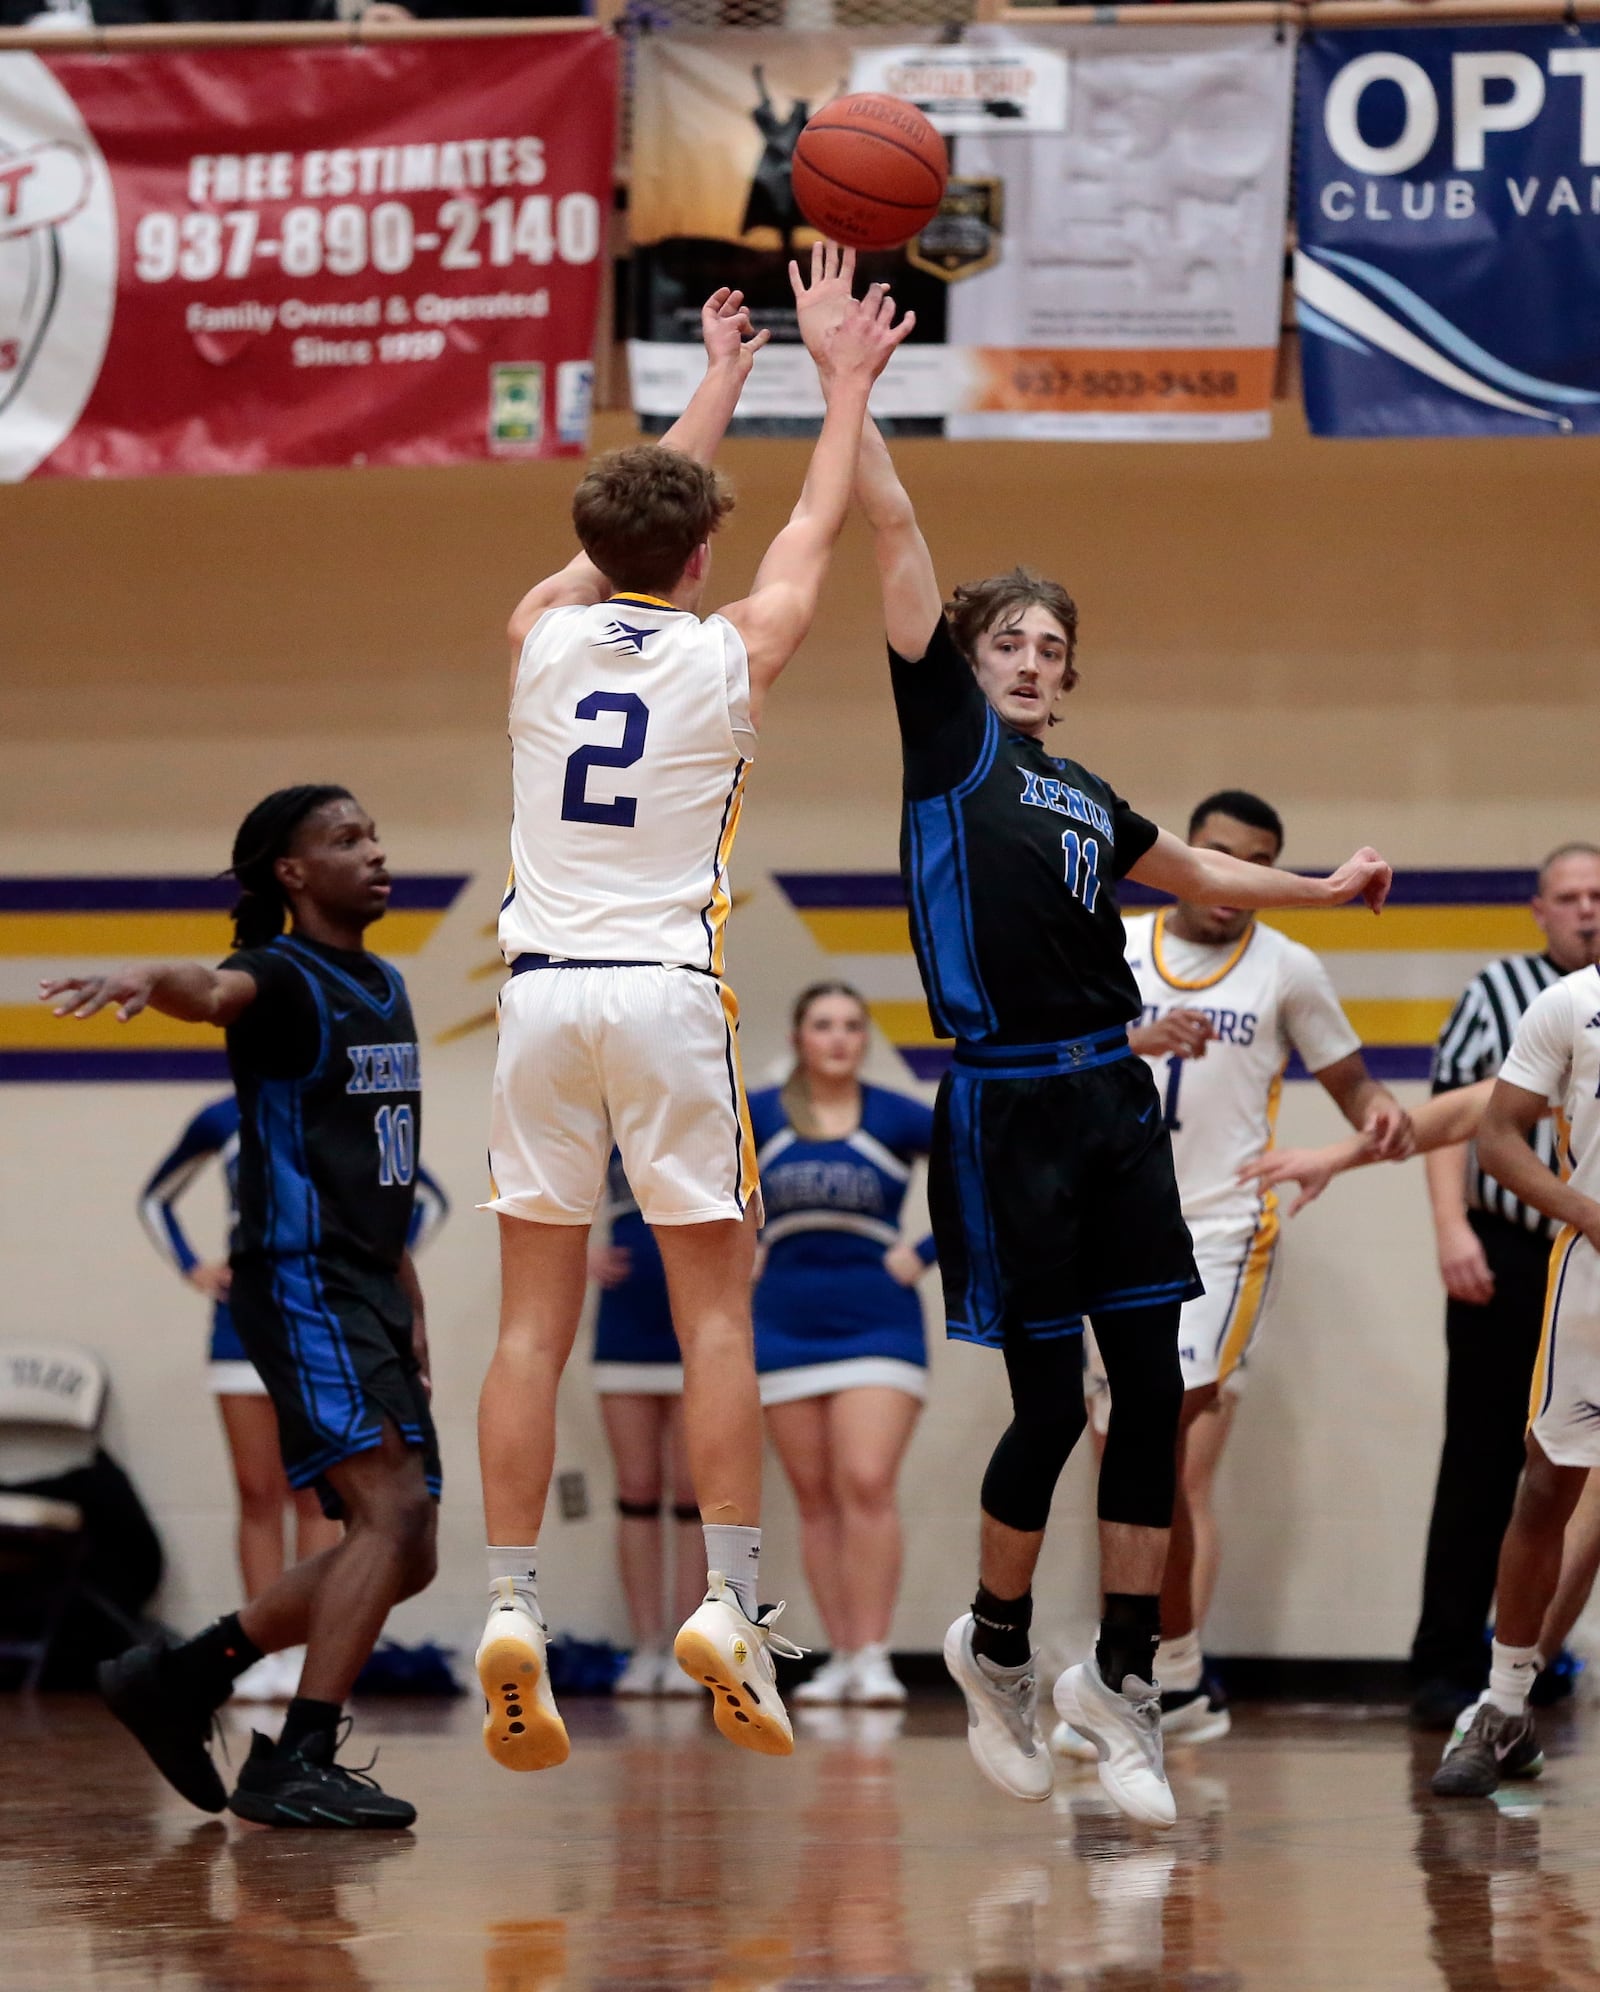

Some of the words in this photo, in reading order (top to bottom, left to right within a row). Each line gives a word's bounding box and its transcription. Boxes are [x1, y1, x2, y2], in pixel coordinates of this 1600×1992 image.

[1324, 48, 1600, 176] OPT
[188, 152, 293, 203] FREE
[302, 136, 546, 199] ESTIMATES
[1319, 181, 1476, 222] CLUB
[135, 193, 600, 283] 937-890-2140
[187, 302, 276, 334] Family
[278, 297, 381, 329] Owned
[385, 295, 411, 325] &
[414, 289, 549, 325] Operated
[292, 337, 373, 367] Since
[561, 690, 649, 828] 2
[1016, 765, 1115, 847] XENIA
[1061, 829, 1101, 914] 11
[374, 1104, 414, 1187] 10
